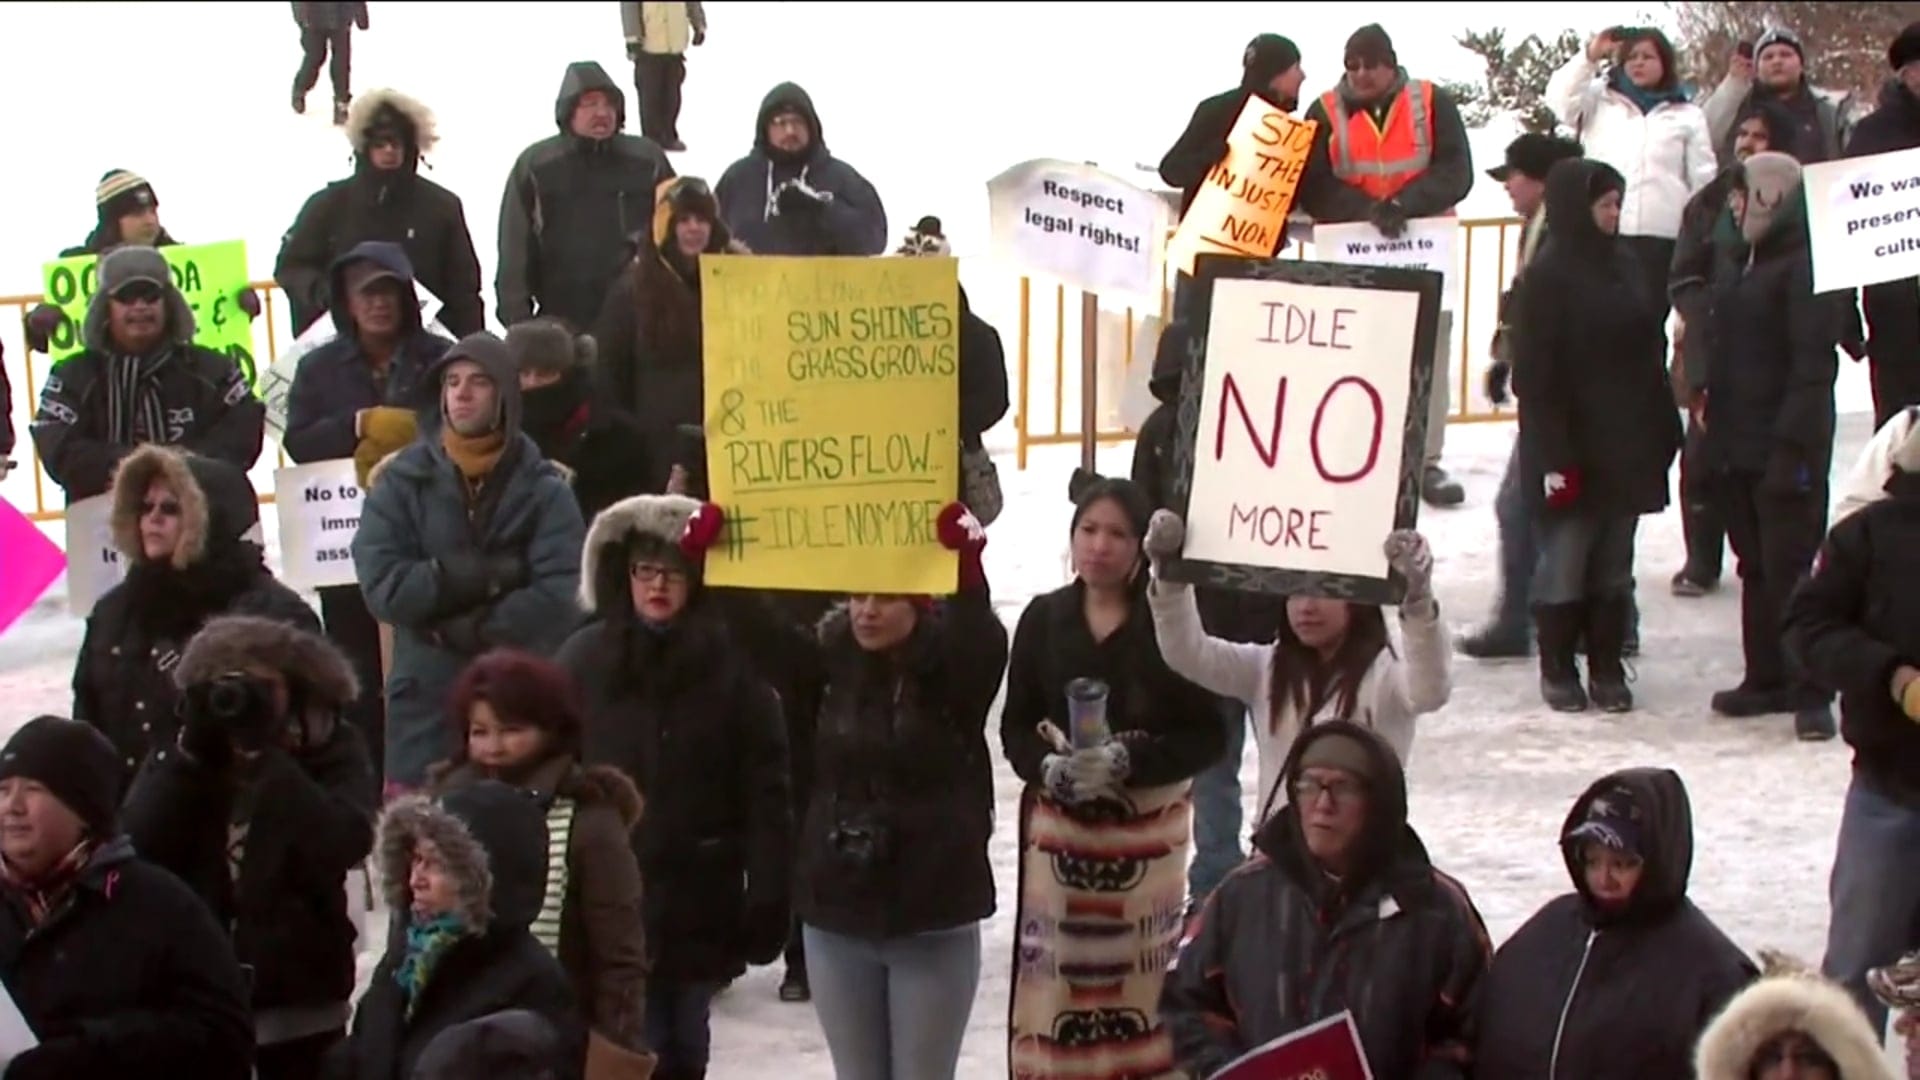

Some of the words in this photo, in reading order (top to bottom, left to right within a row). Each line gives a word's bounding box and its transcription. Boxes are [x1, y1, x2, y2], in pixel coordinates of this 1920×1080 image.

[1252, 113, 1312, 152] STO
[1256, 152, 1304, 183] THE
[1043, 180, 1124, 215] Respect
[1209, 163, 1289, 214] INJUST
[1849, 181, 1884, 199] We
[1891, 176, 1920, 192] wa
[1025, 207, 1073, 233] legal
[1079, 222, 1140, 253] rights!
[1847, 207, 1920, 235] preserv
[1347, 242, 1370, 255] We
[1376, 239, 1413, 253] want
[1418, 239, 1434, 250] to
[787, 310, 840, 343] SUN
[850, 302, 953, 343] SHINES
[1256, 301, 1357, 350] IDLE
[787, 349, 868, 381] GRASS
[870, 343, 956, 380] GROWS
[719, 389, 746, 436] &
[756, 399, 799, 427] THE
[1215, 371, 1384, 483] NO
[724, 436, 844, 486] RIVERS
[305, 485, 332, 502] No
[338, 484, 358, 500] to
[321, 516, 361, 531] imm
[1228, 502, 1333, 551] MORE
[316, 547, 350, 562] ass
